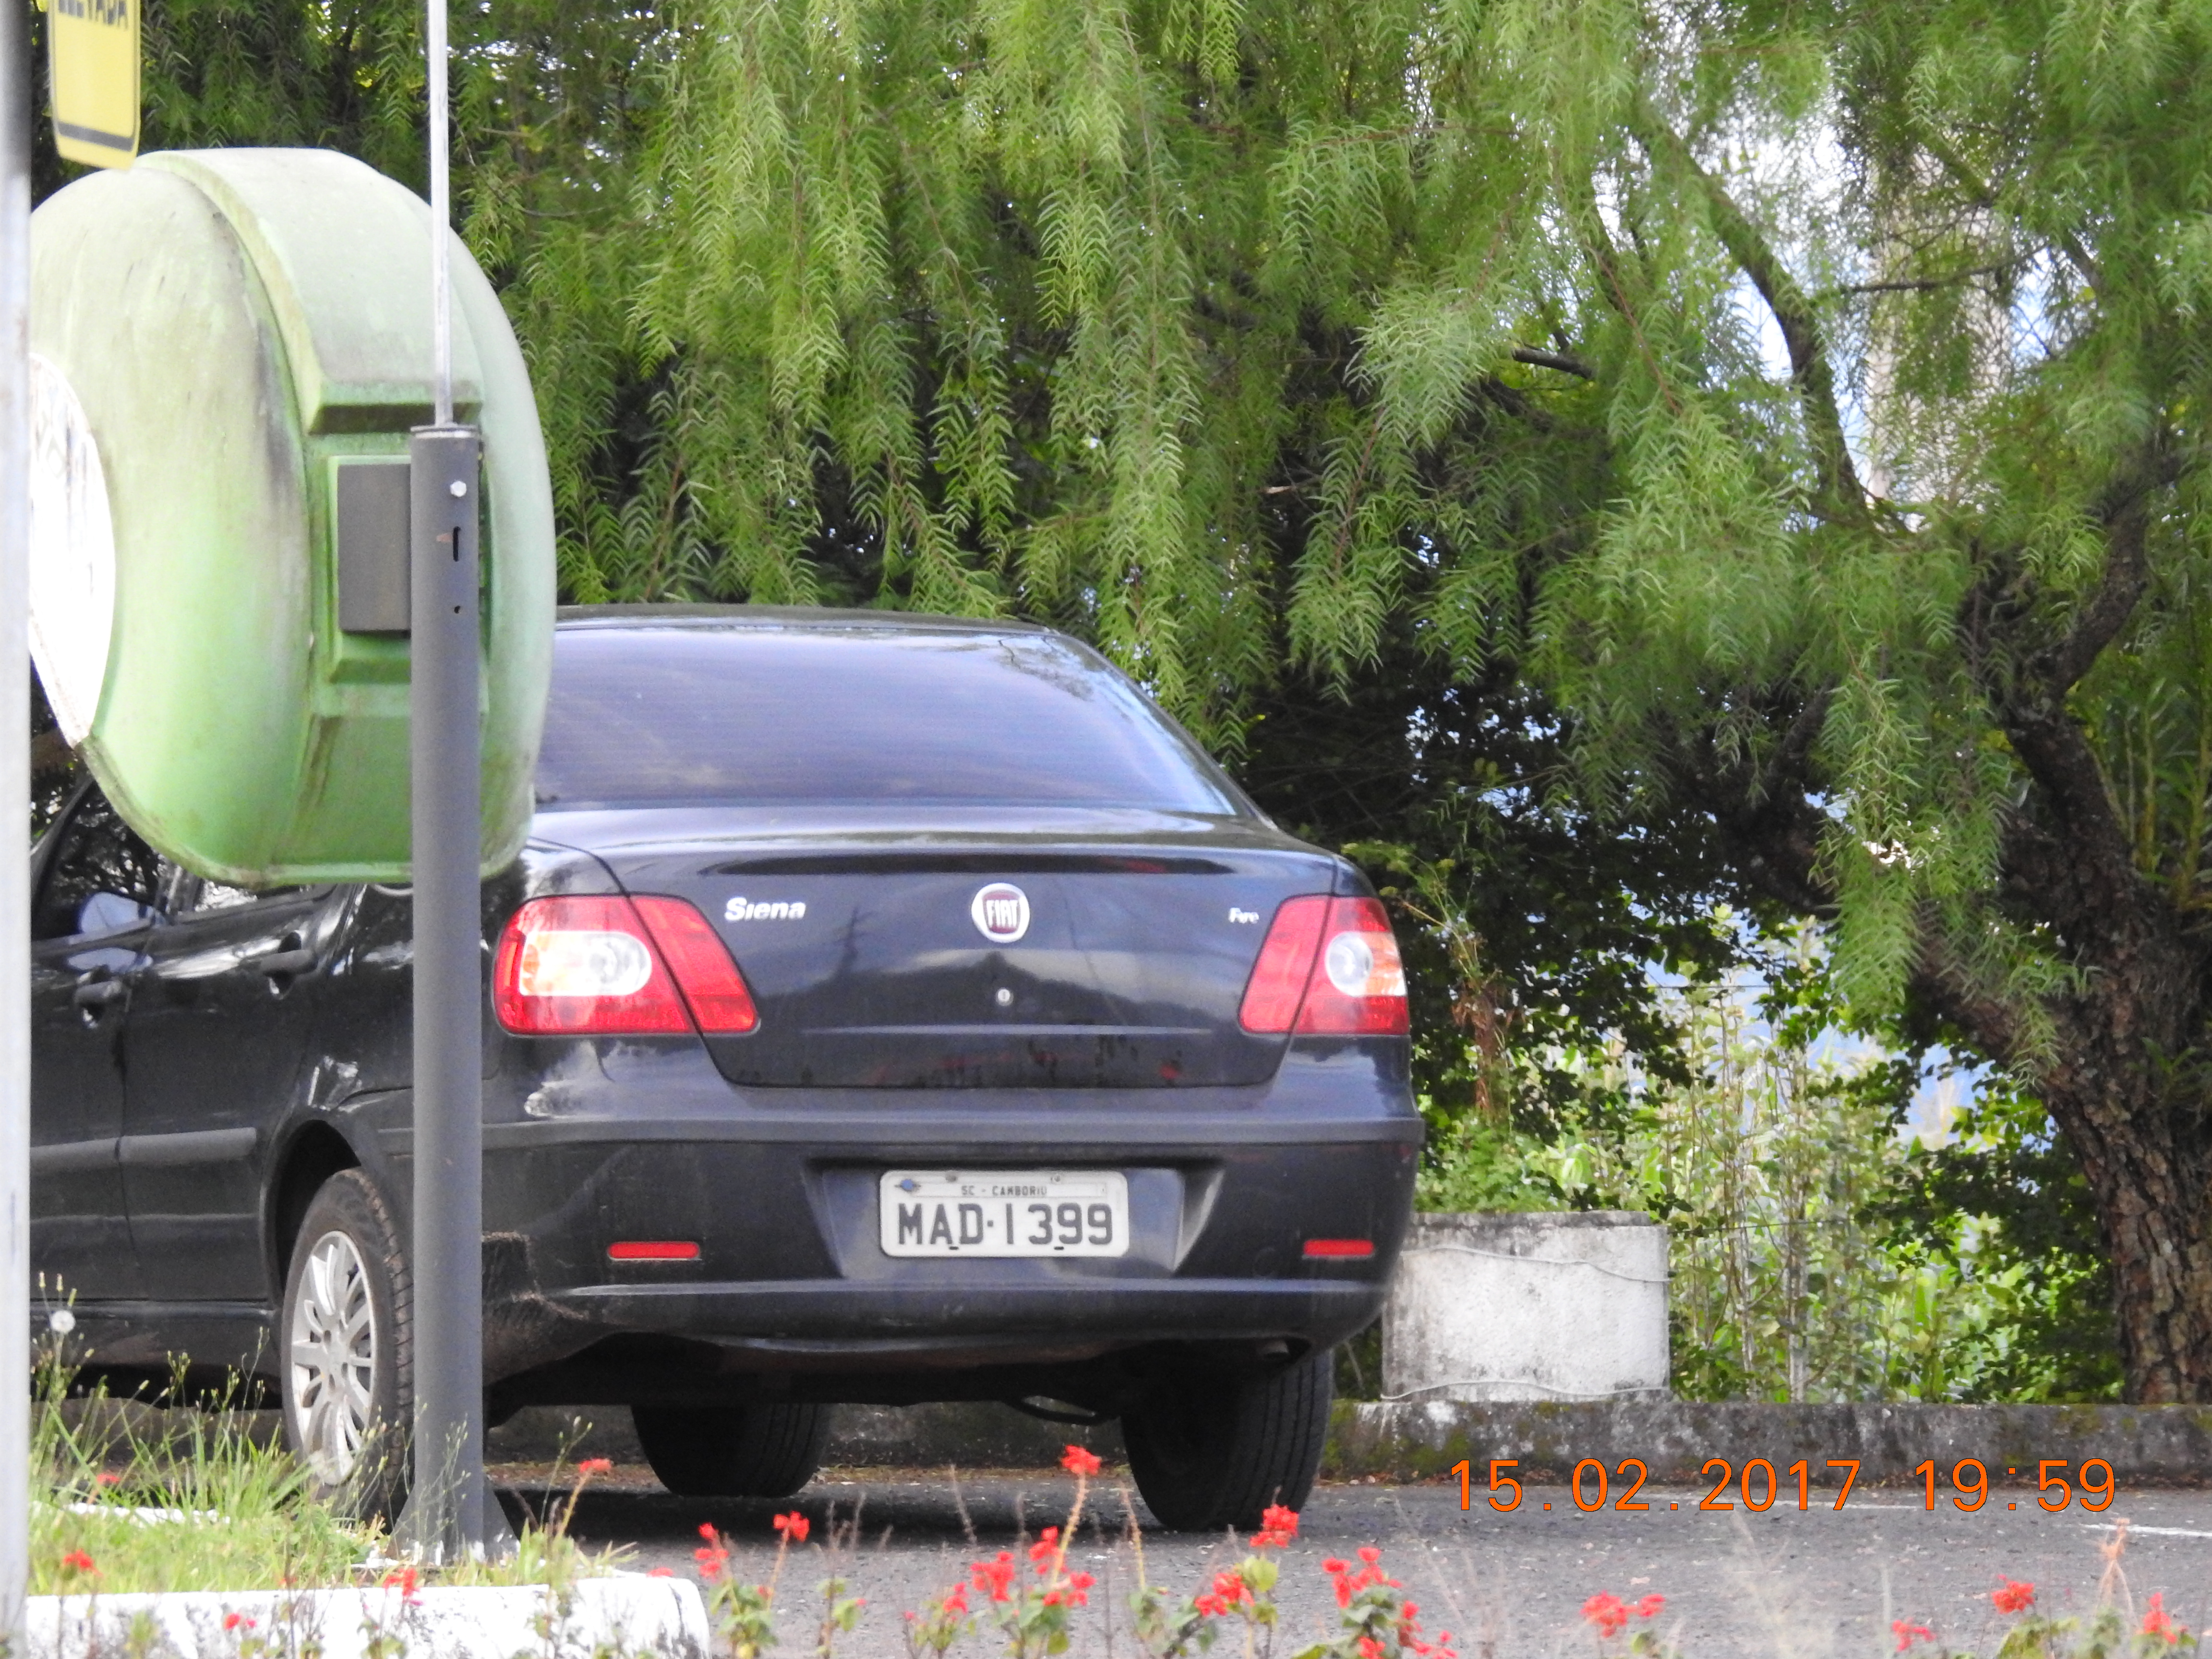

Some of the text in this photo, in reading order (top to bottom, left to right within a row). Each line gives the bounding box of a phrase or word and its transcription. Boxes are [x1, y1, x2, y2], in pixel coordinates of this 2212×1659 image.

[725, 897, 806, 921] Siena
[986, 899, 1019, 927] FIAT
[961, 1185, 975, 1195] SC
